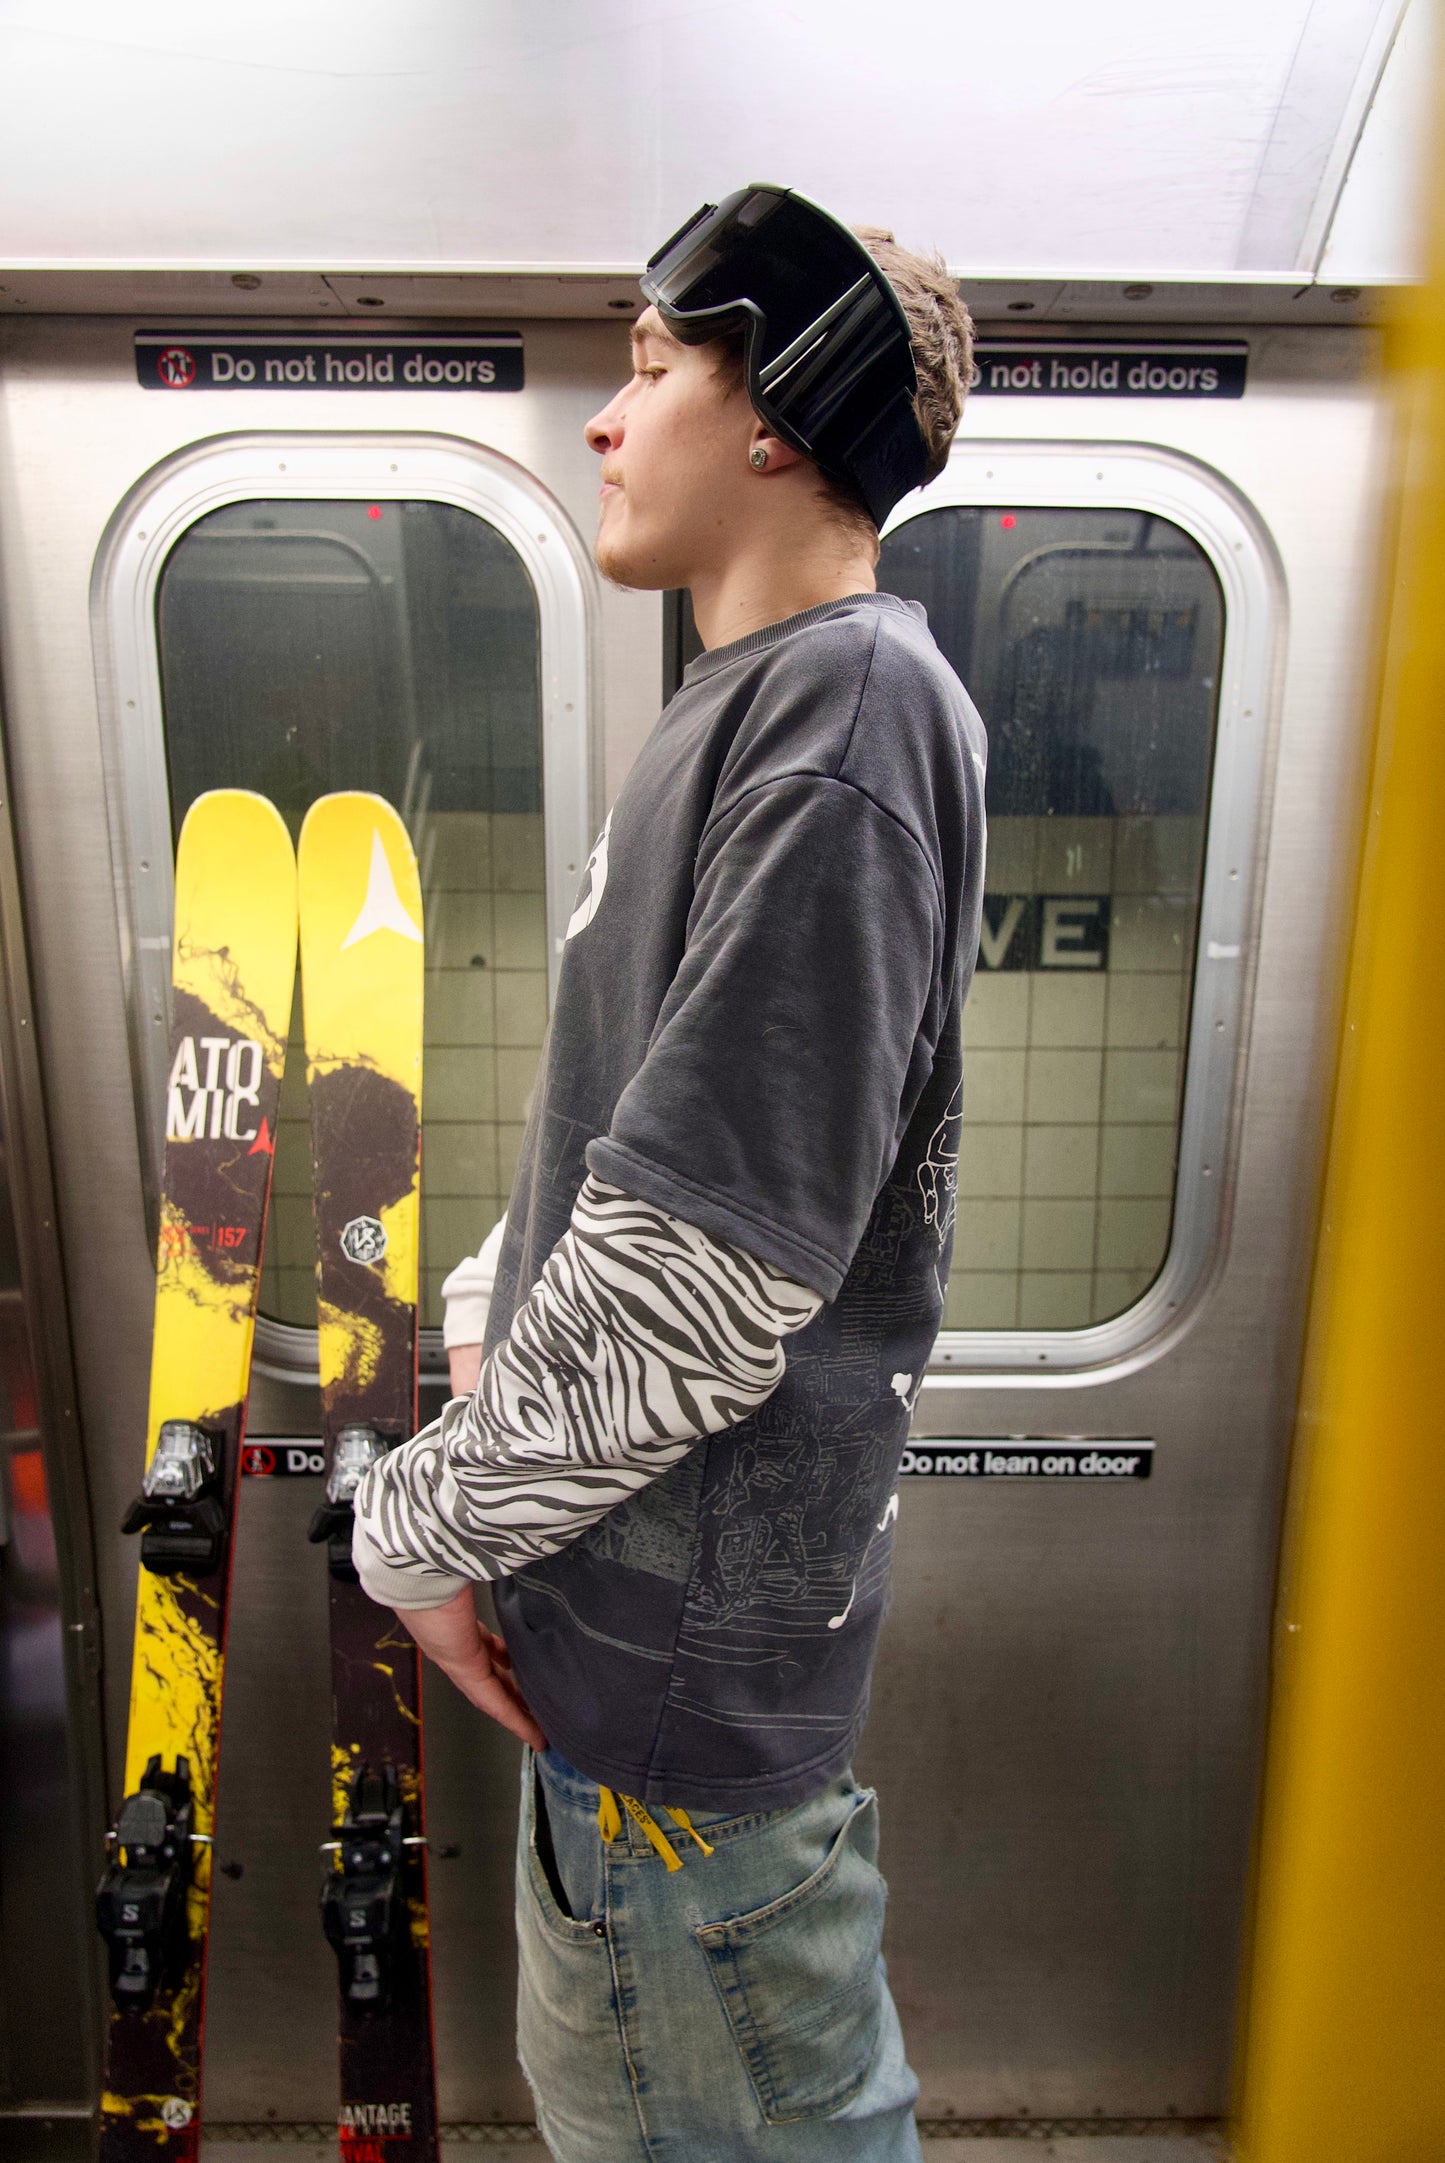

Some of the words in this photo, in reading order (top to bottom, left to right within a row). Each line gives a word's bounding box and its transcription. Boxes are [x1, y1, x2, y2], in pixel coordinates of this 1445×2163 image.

[212, 353, 255, 382] Do
[265, 354, 317, 382] not
[325, 353, 394, 383] hold
[403, 354, 496, 383] doors
[990, 361, 1042, 389] not
[1051, 360, 1119, 390] hold
[1127, 361, 1219, 391] doors
[218, 1226, 247, 1248] 157
[287, 1450, 325, 1472] Do
[899, 1451, 934, 1474] Do
[935, 1452, 979, 1474] not
[984, 1451, 1039, 1475] lean
[1042, 1456, 1076, 1475] on
[1079, 1452, 1141, 1475] door
